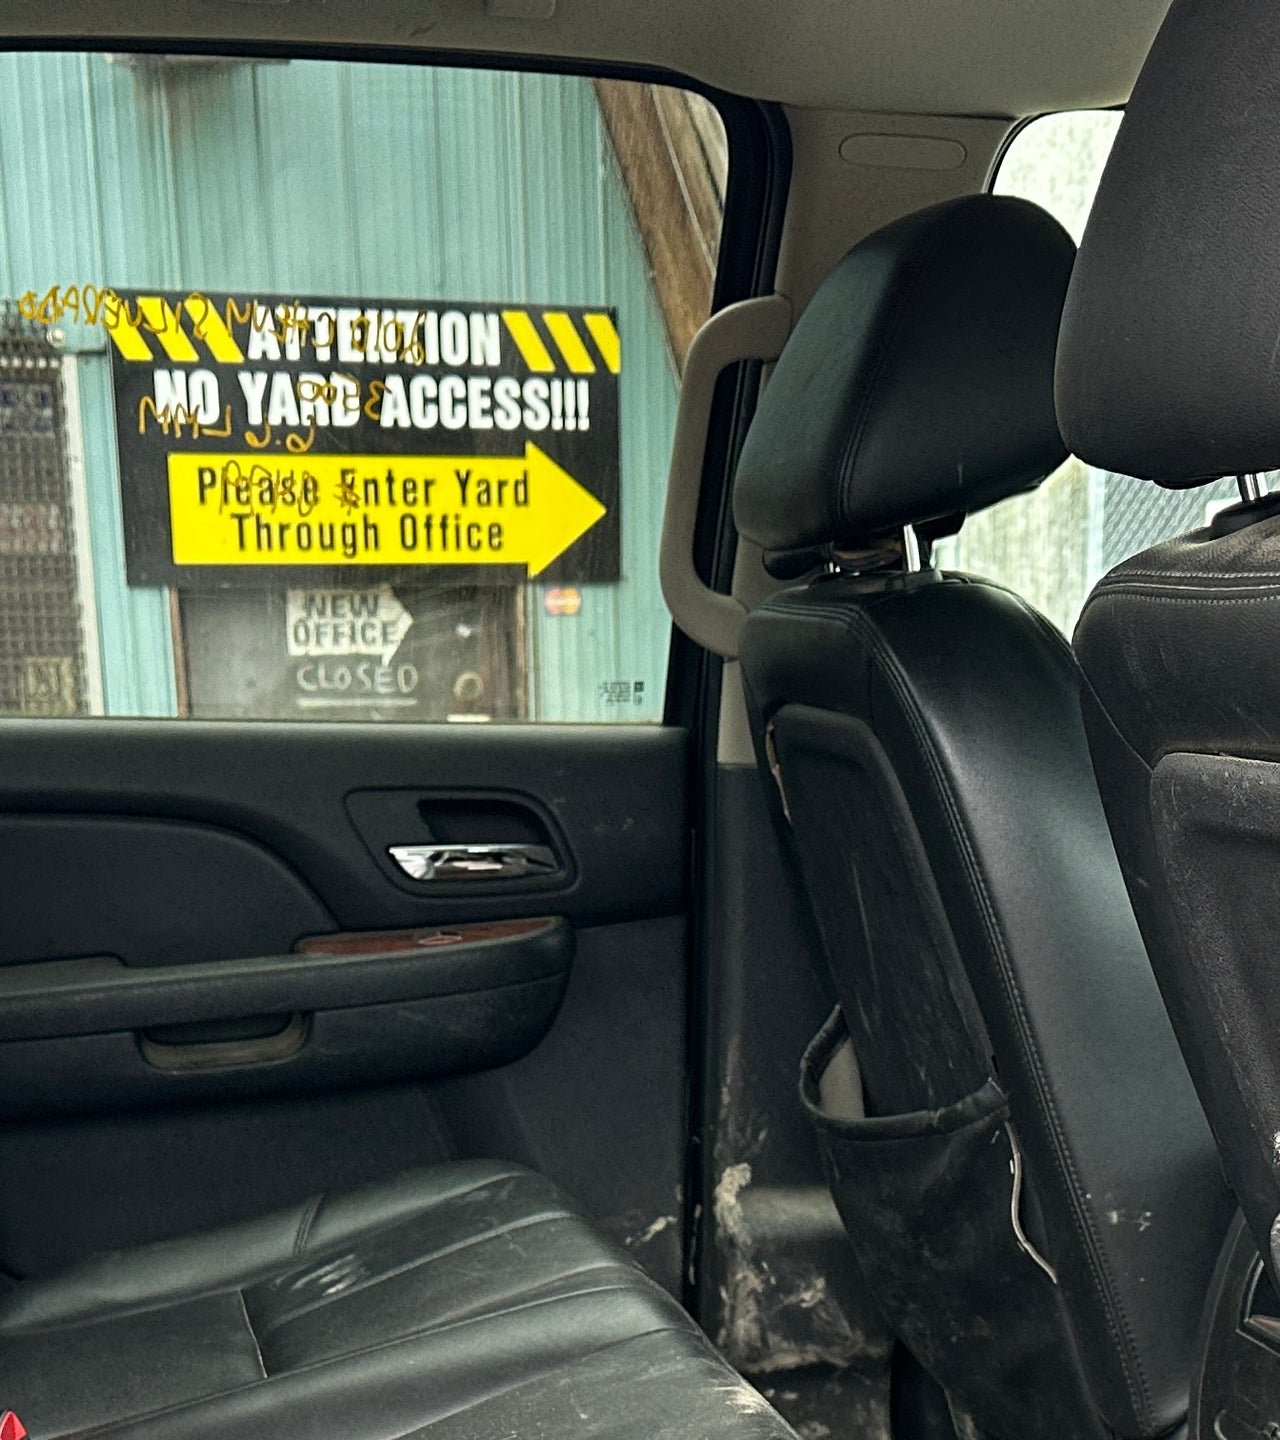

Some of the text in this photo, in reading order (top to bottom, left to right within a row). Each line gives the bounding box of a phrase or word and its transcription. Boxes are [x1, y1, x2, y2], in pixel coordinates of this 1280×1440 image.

[248, 306, 501, 367] ATTENTION
[153, 369, 590, 431] NO YARD ACCESS!!!
[198, 467, 529, 508] Please Enter Yard
[230, 514, 503, 559] Through Office
[303, 595, 377, 619] NEW
[293, 620, 399, 647] OFFICE
[297, 662, 418, 693] CLOSED
